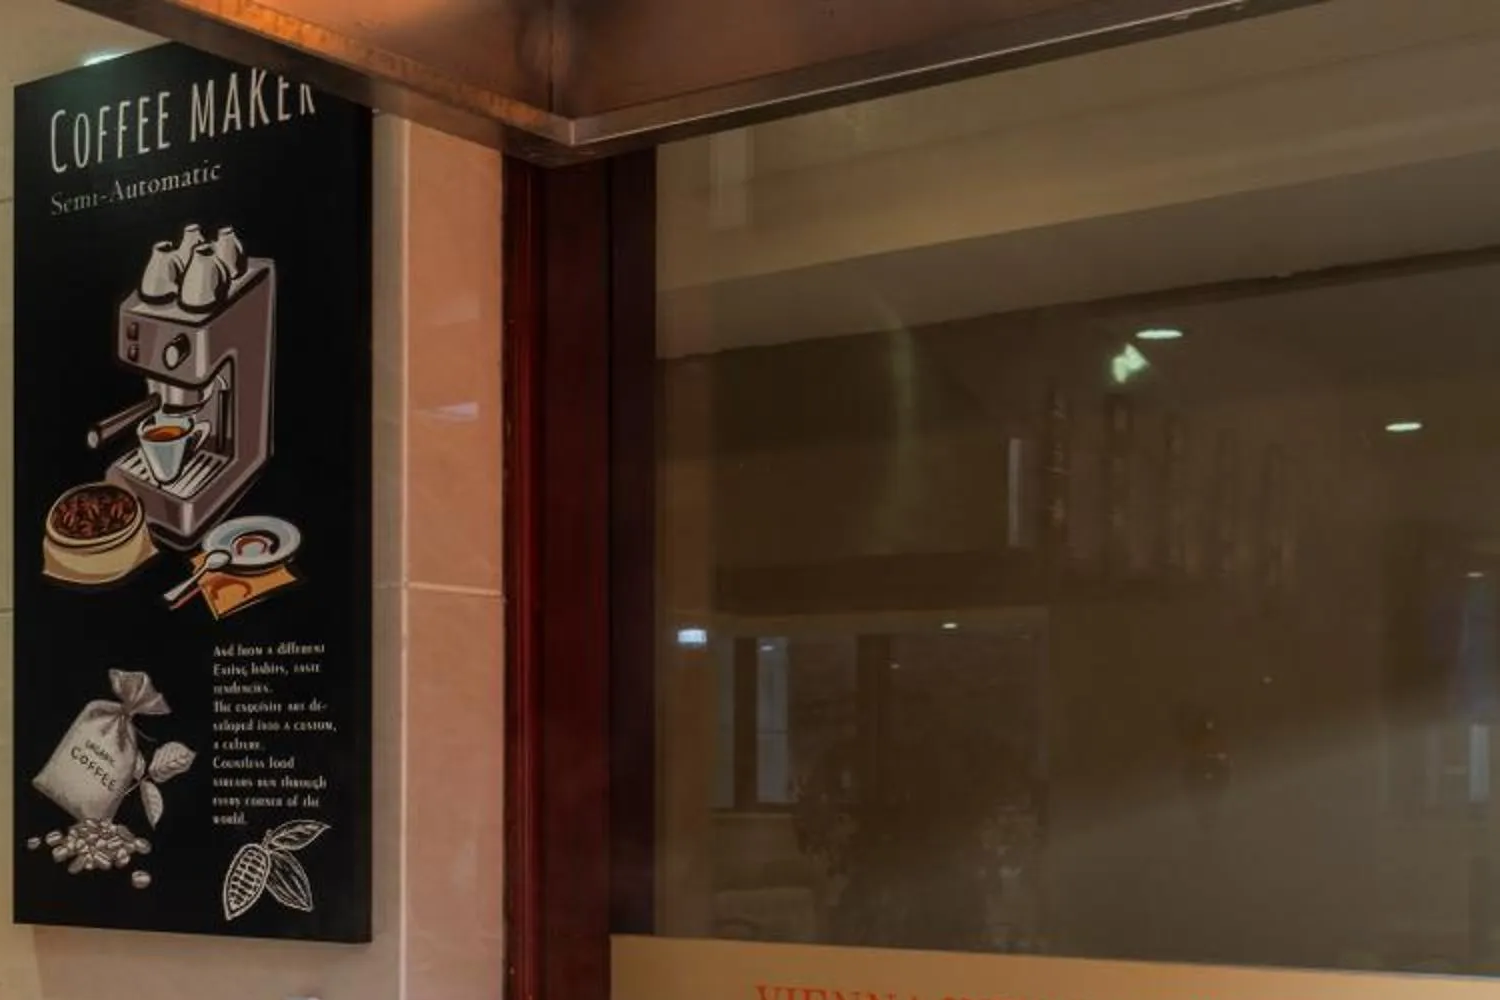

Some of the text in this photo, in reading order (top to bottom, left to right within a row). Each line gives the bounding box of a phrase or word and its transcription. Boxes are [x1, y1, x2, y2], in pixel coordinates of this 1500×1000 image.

[51, 91, 171, 173] COFFEE
[51, 159, 223, 216] Semi-Automatic
[71, 745, 117, 792] COFFEE
